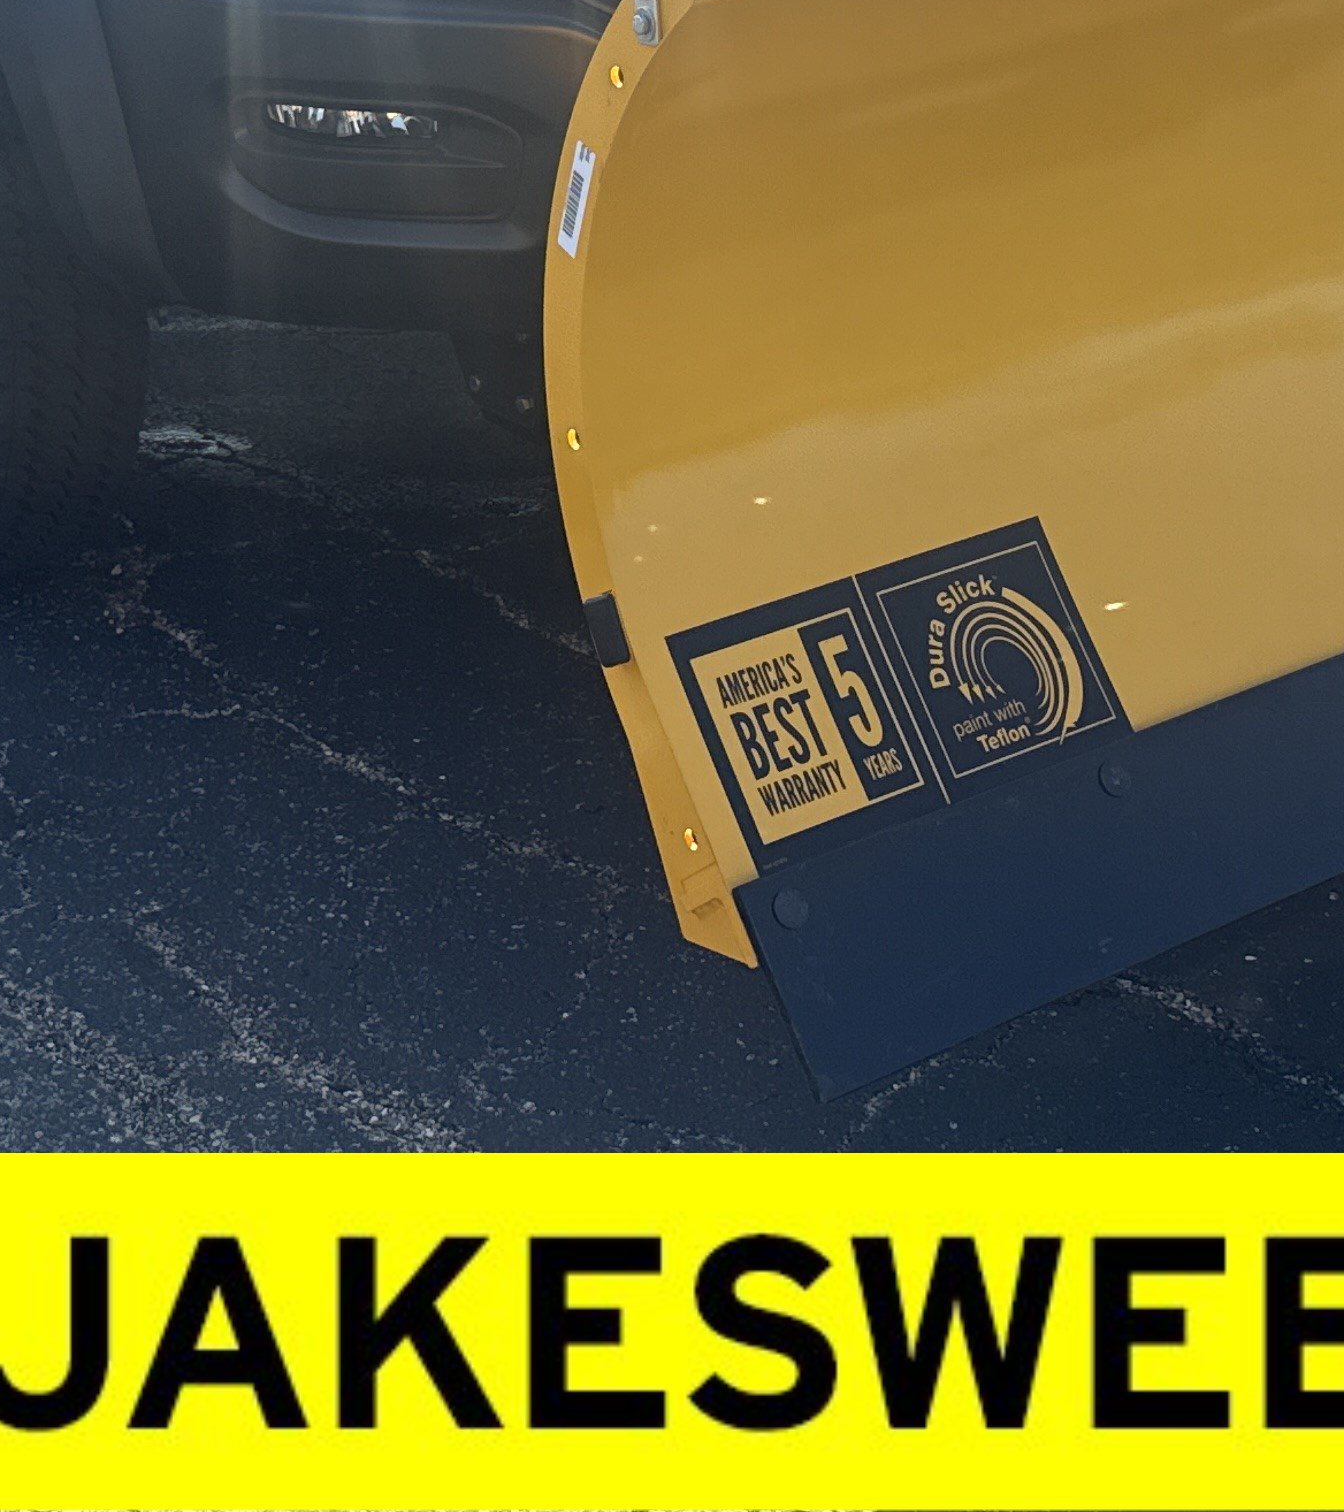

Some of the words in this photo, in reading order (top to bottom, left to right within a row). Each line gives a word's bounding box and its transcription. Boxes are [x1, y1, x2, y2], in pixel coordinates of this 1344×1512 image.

[936, 573, 997, 615] Slick
[715, 653, 804, 709] AMERICA'S
[929, 618, 951, 690] Dura
[818, 634, 884, 748] 5
[730, 690, 828, 781] BEST
[953, 709, 994, 743] paint
[994, 698, 1027, 723] with
[758, 760, 848, 818] WARRANTY
[863, 748, 904, 782] YEARS
